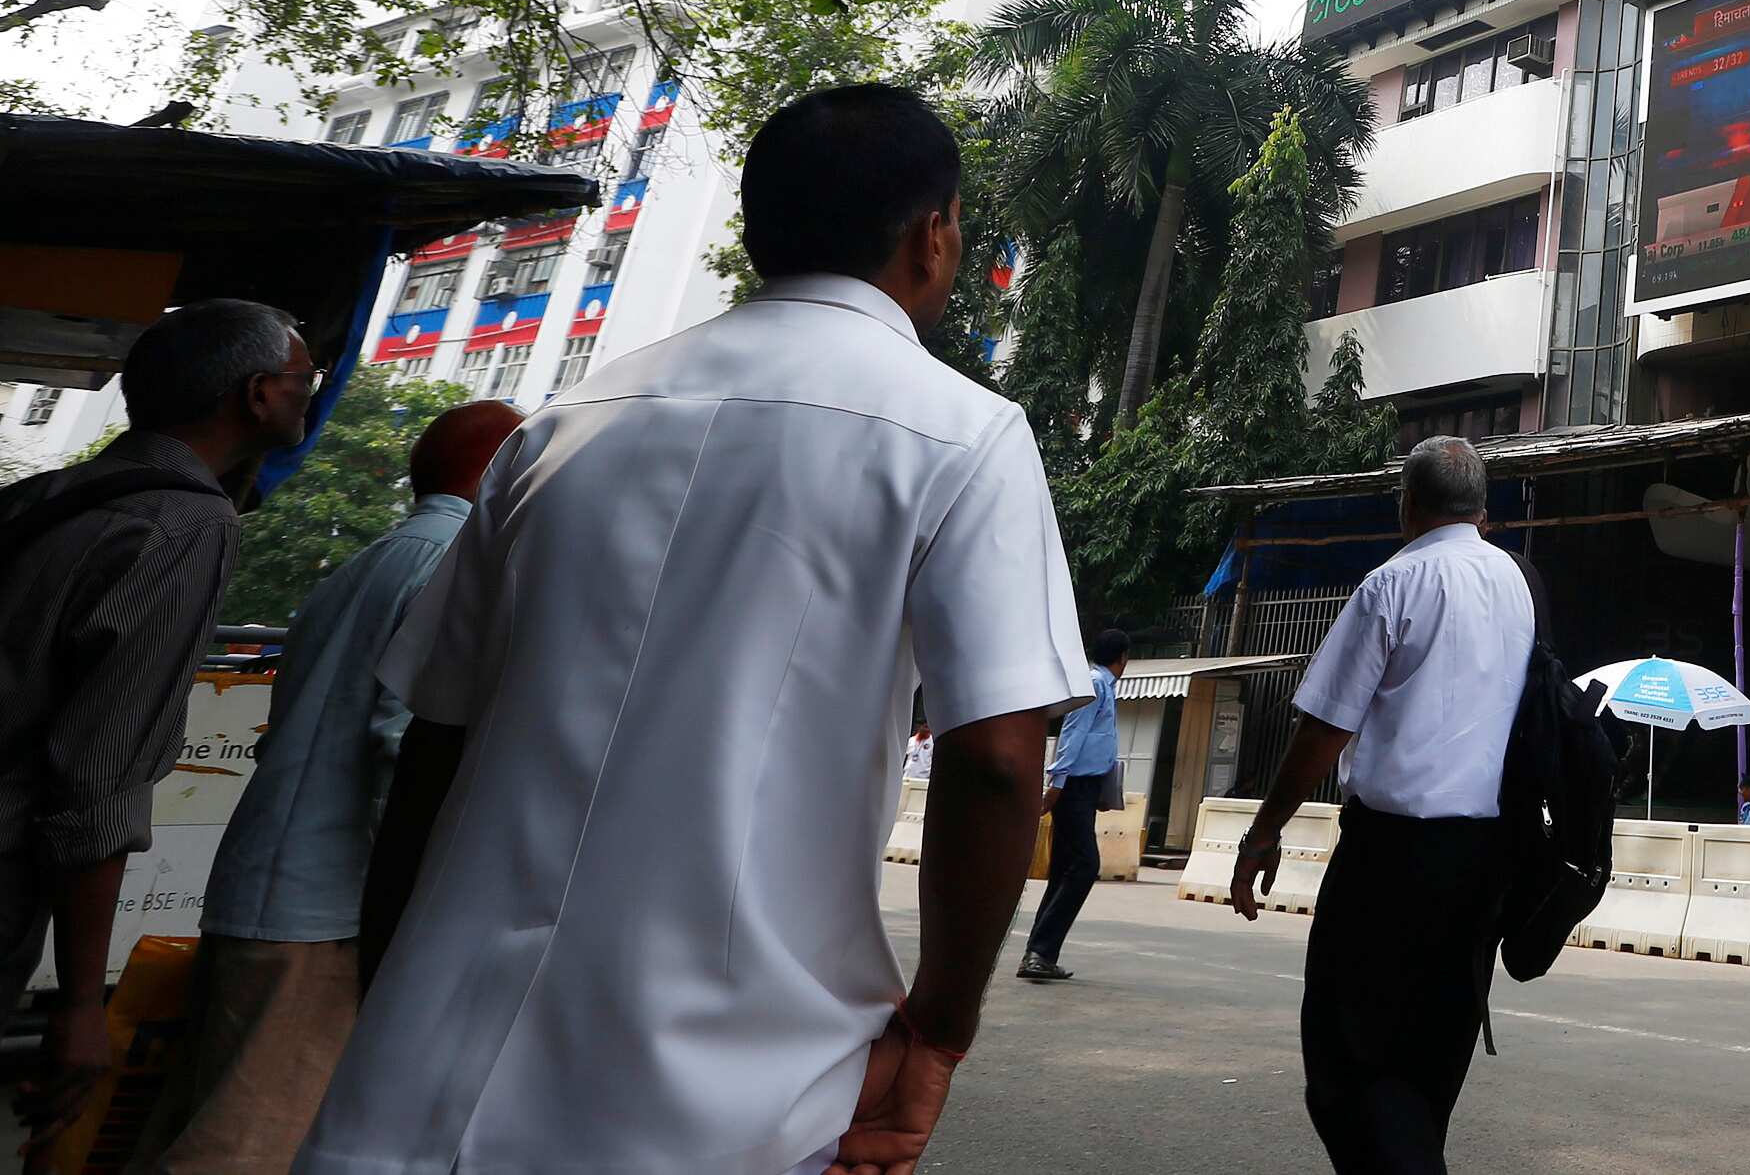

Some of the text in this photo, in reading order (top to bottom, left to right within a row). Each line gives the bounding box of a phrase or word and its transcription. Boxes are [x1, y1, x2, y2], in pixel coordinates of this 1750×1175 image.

[1712, 52, 1744, 72] 32/32
[1694, 686, 1730, 700] BSE
[142, 891, 177, 912] BSE
